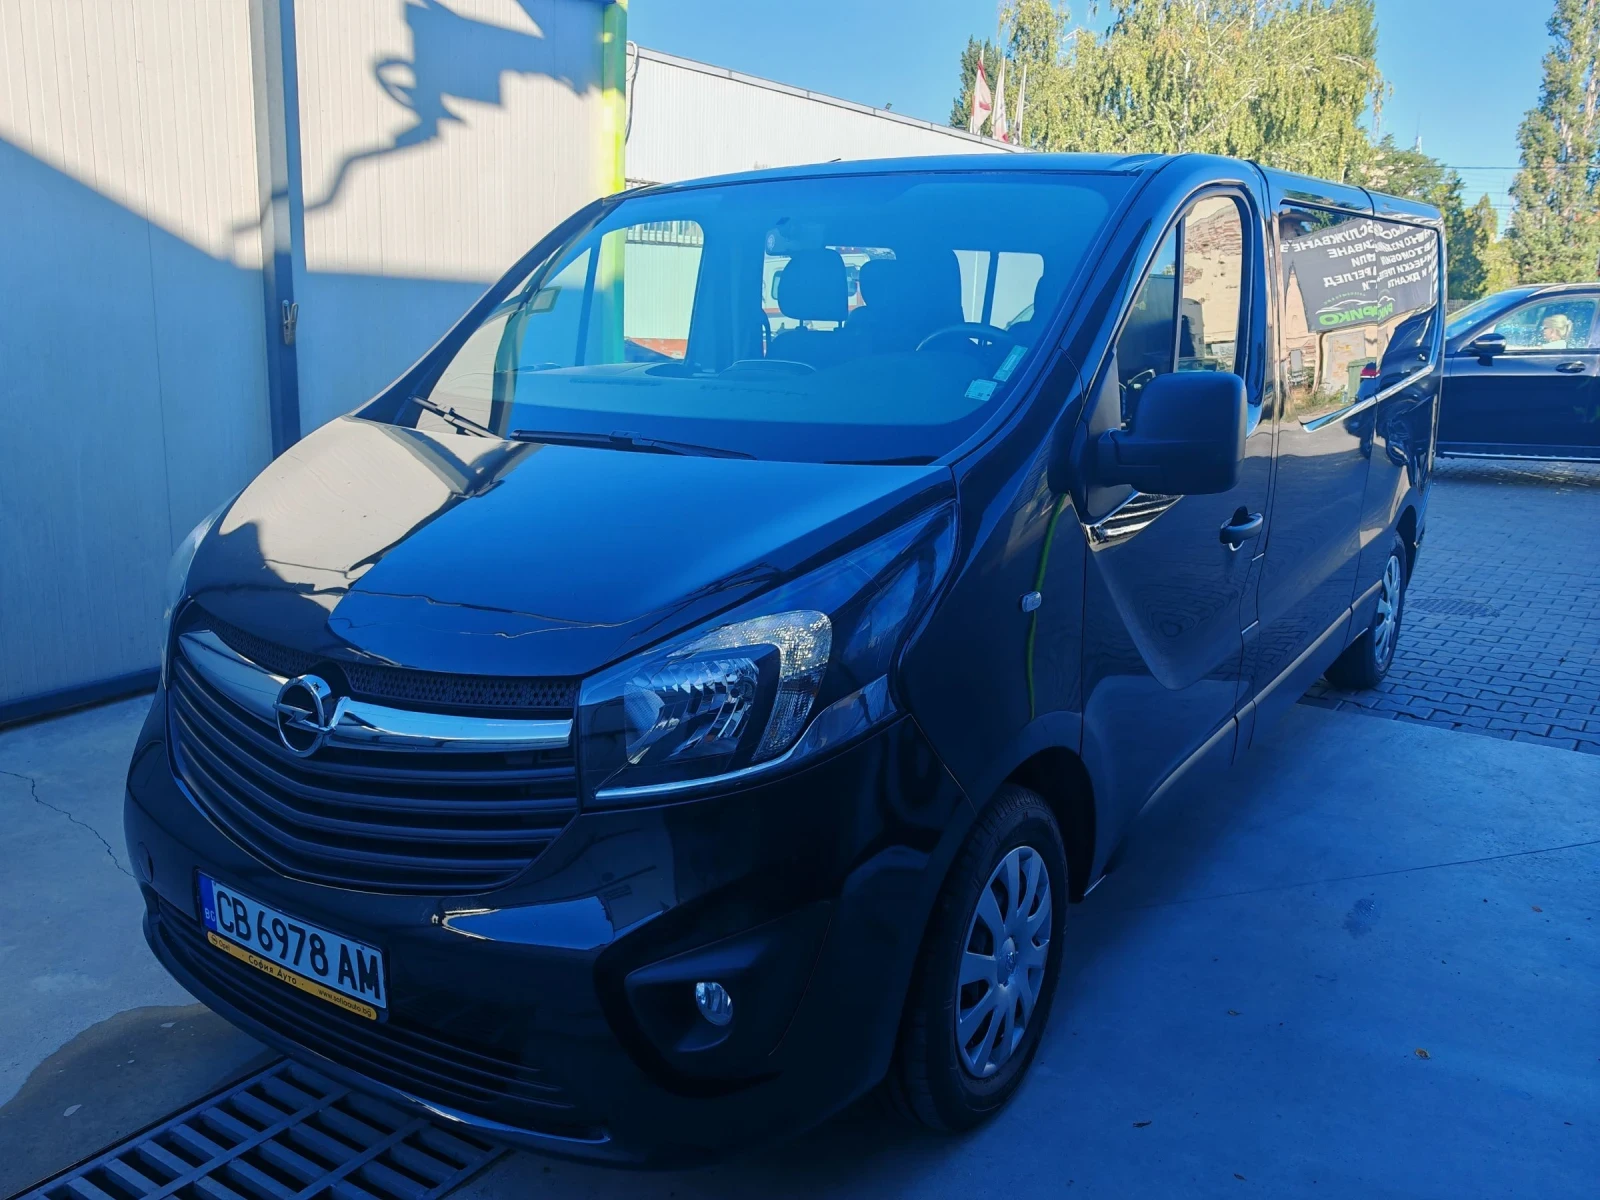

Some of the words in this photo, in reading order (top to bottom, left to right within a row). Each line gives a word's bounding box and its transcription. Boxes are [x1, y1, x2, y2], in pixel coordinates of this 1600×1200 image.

[204, 907, 216, 922] BG
[248, 955, 274, 974] София
[277, 967, 297, 985] Ауто
[318, 988, 372, 1018] www.sofiaauto.bg
